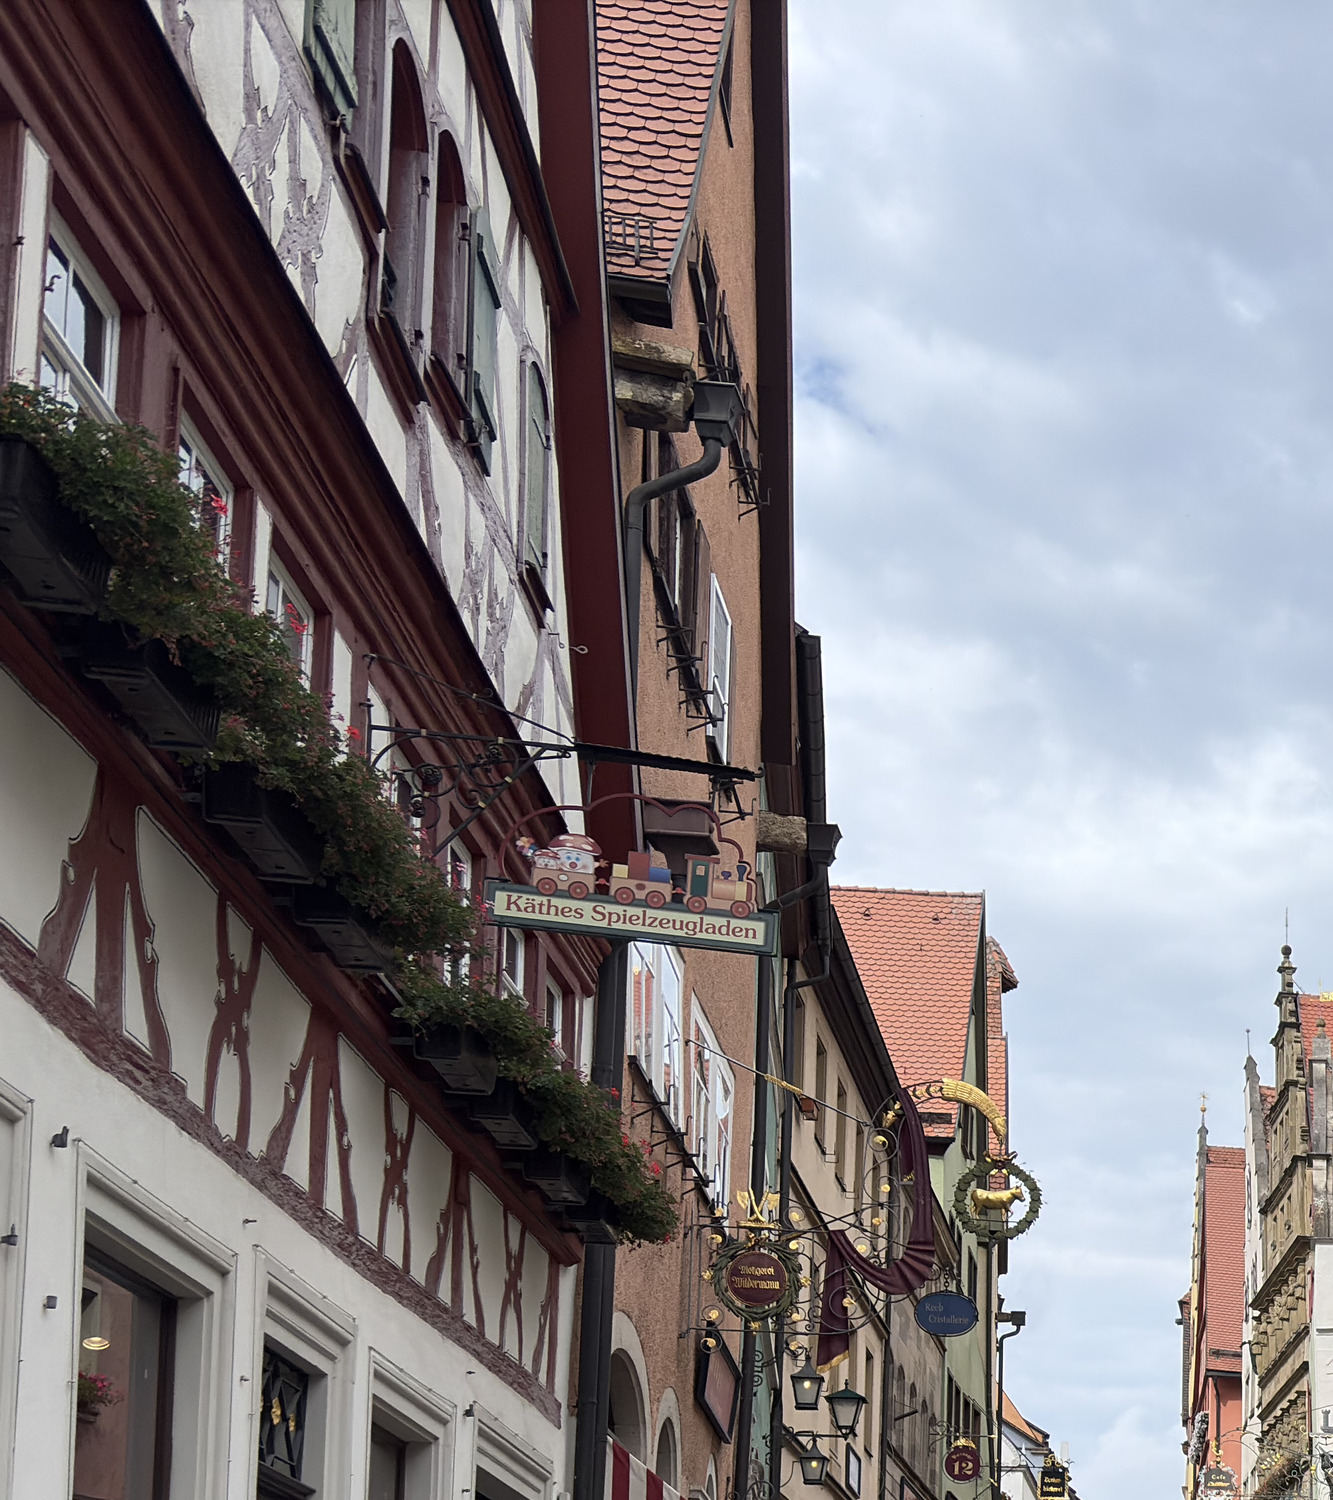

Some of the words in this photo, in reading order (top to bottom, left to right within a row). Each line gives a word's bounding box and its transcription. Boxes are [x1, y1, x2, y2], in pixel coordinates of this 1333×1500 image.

[505, 894, 584, 919] Käthes
[591, 904, 758, 939] Spielzeugladen
[952, 1461, 974, 1475] 12
